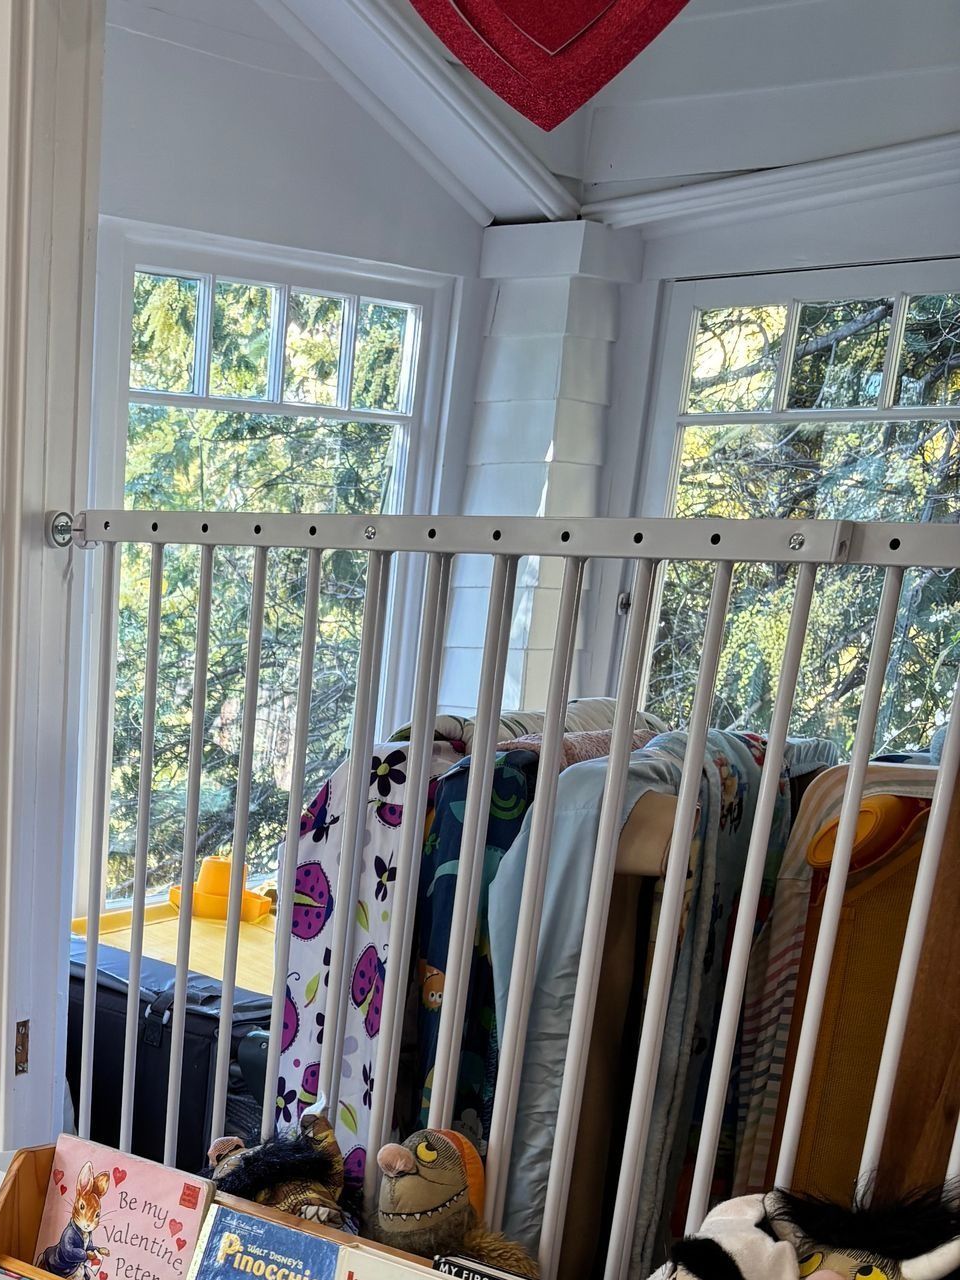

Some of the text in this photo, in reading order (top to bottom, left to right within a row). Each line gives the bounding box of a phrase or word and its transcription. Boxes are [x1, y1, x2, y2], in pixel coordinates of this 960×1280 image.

[119, 1191, 169, 1229] Be my
[103, 1223, 183, 1276] Valentine,
[247, 1244, 304, 1269] WALT DISNEY'S
[439, 1263, 458, 1277] MY
